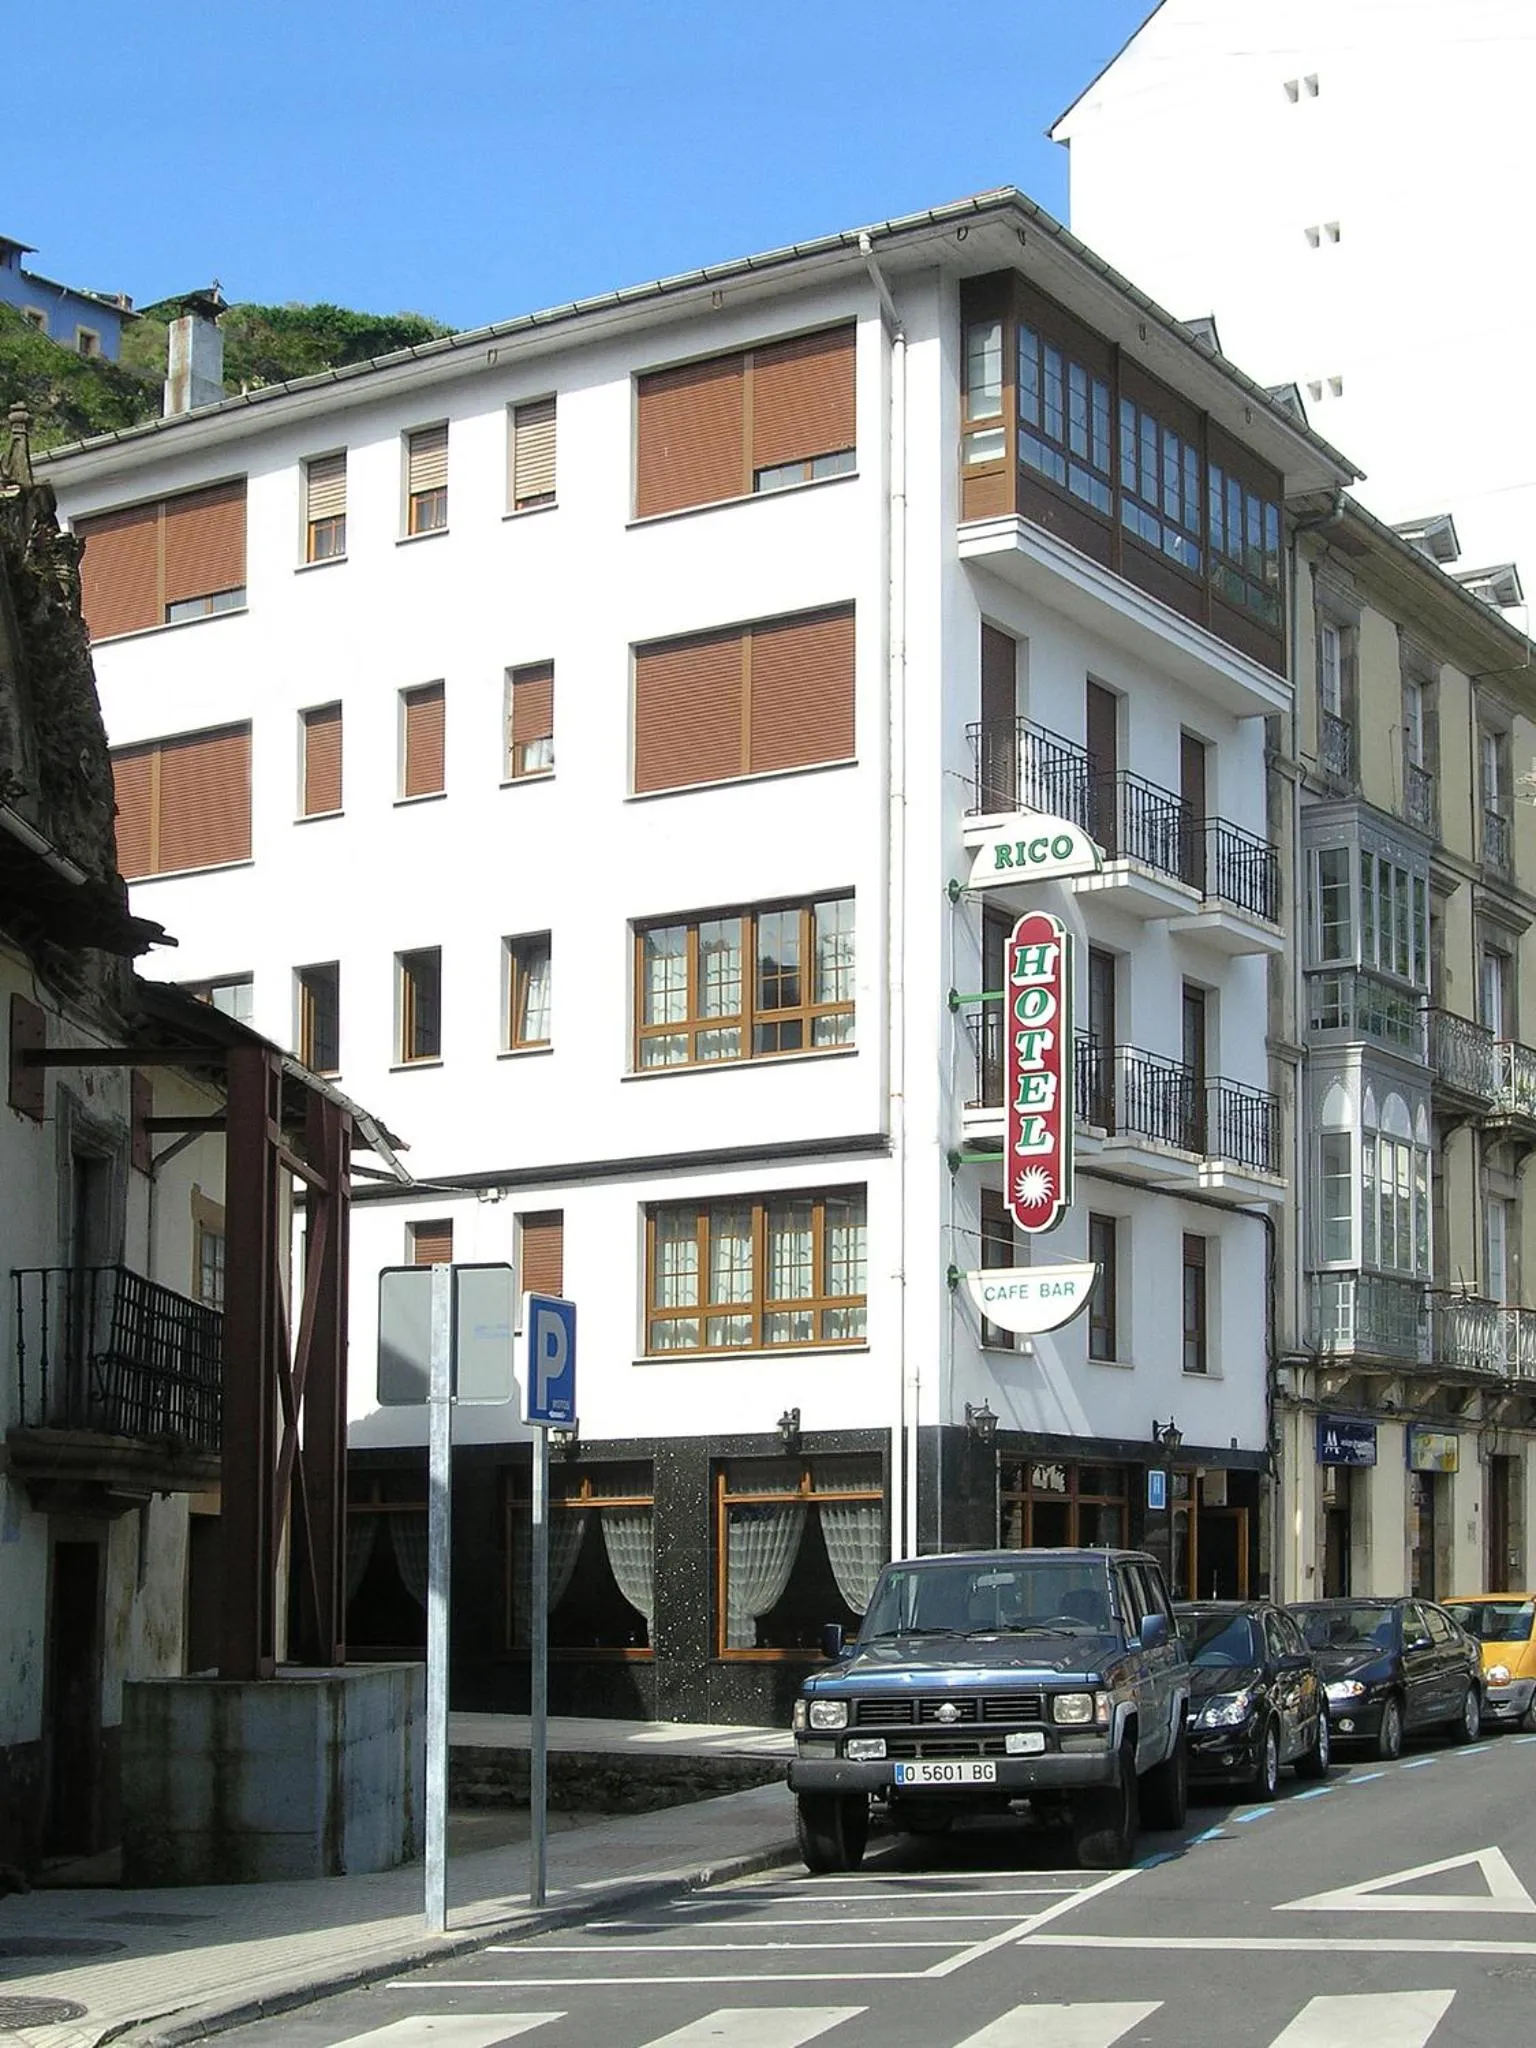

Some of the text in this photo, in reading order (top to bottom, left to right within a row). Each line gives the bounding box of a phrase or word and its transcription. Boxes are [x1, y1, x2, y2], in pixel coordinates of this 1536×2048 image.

[994, 834, 1074, 869] RICO
[1012, 944, 1060, 1157] HOTEL
[984, 1281, 1075, 1301] CAFE BAR
[537, 1310, 568, 1410] P
[922, 1765, 963, 1781] 5601
[972, 1764, 993, 1780] BG
